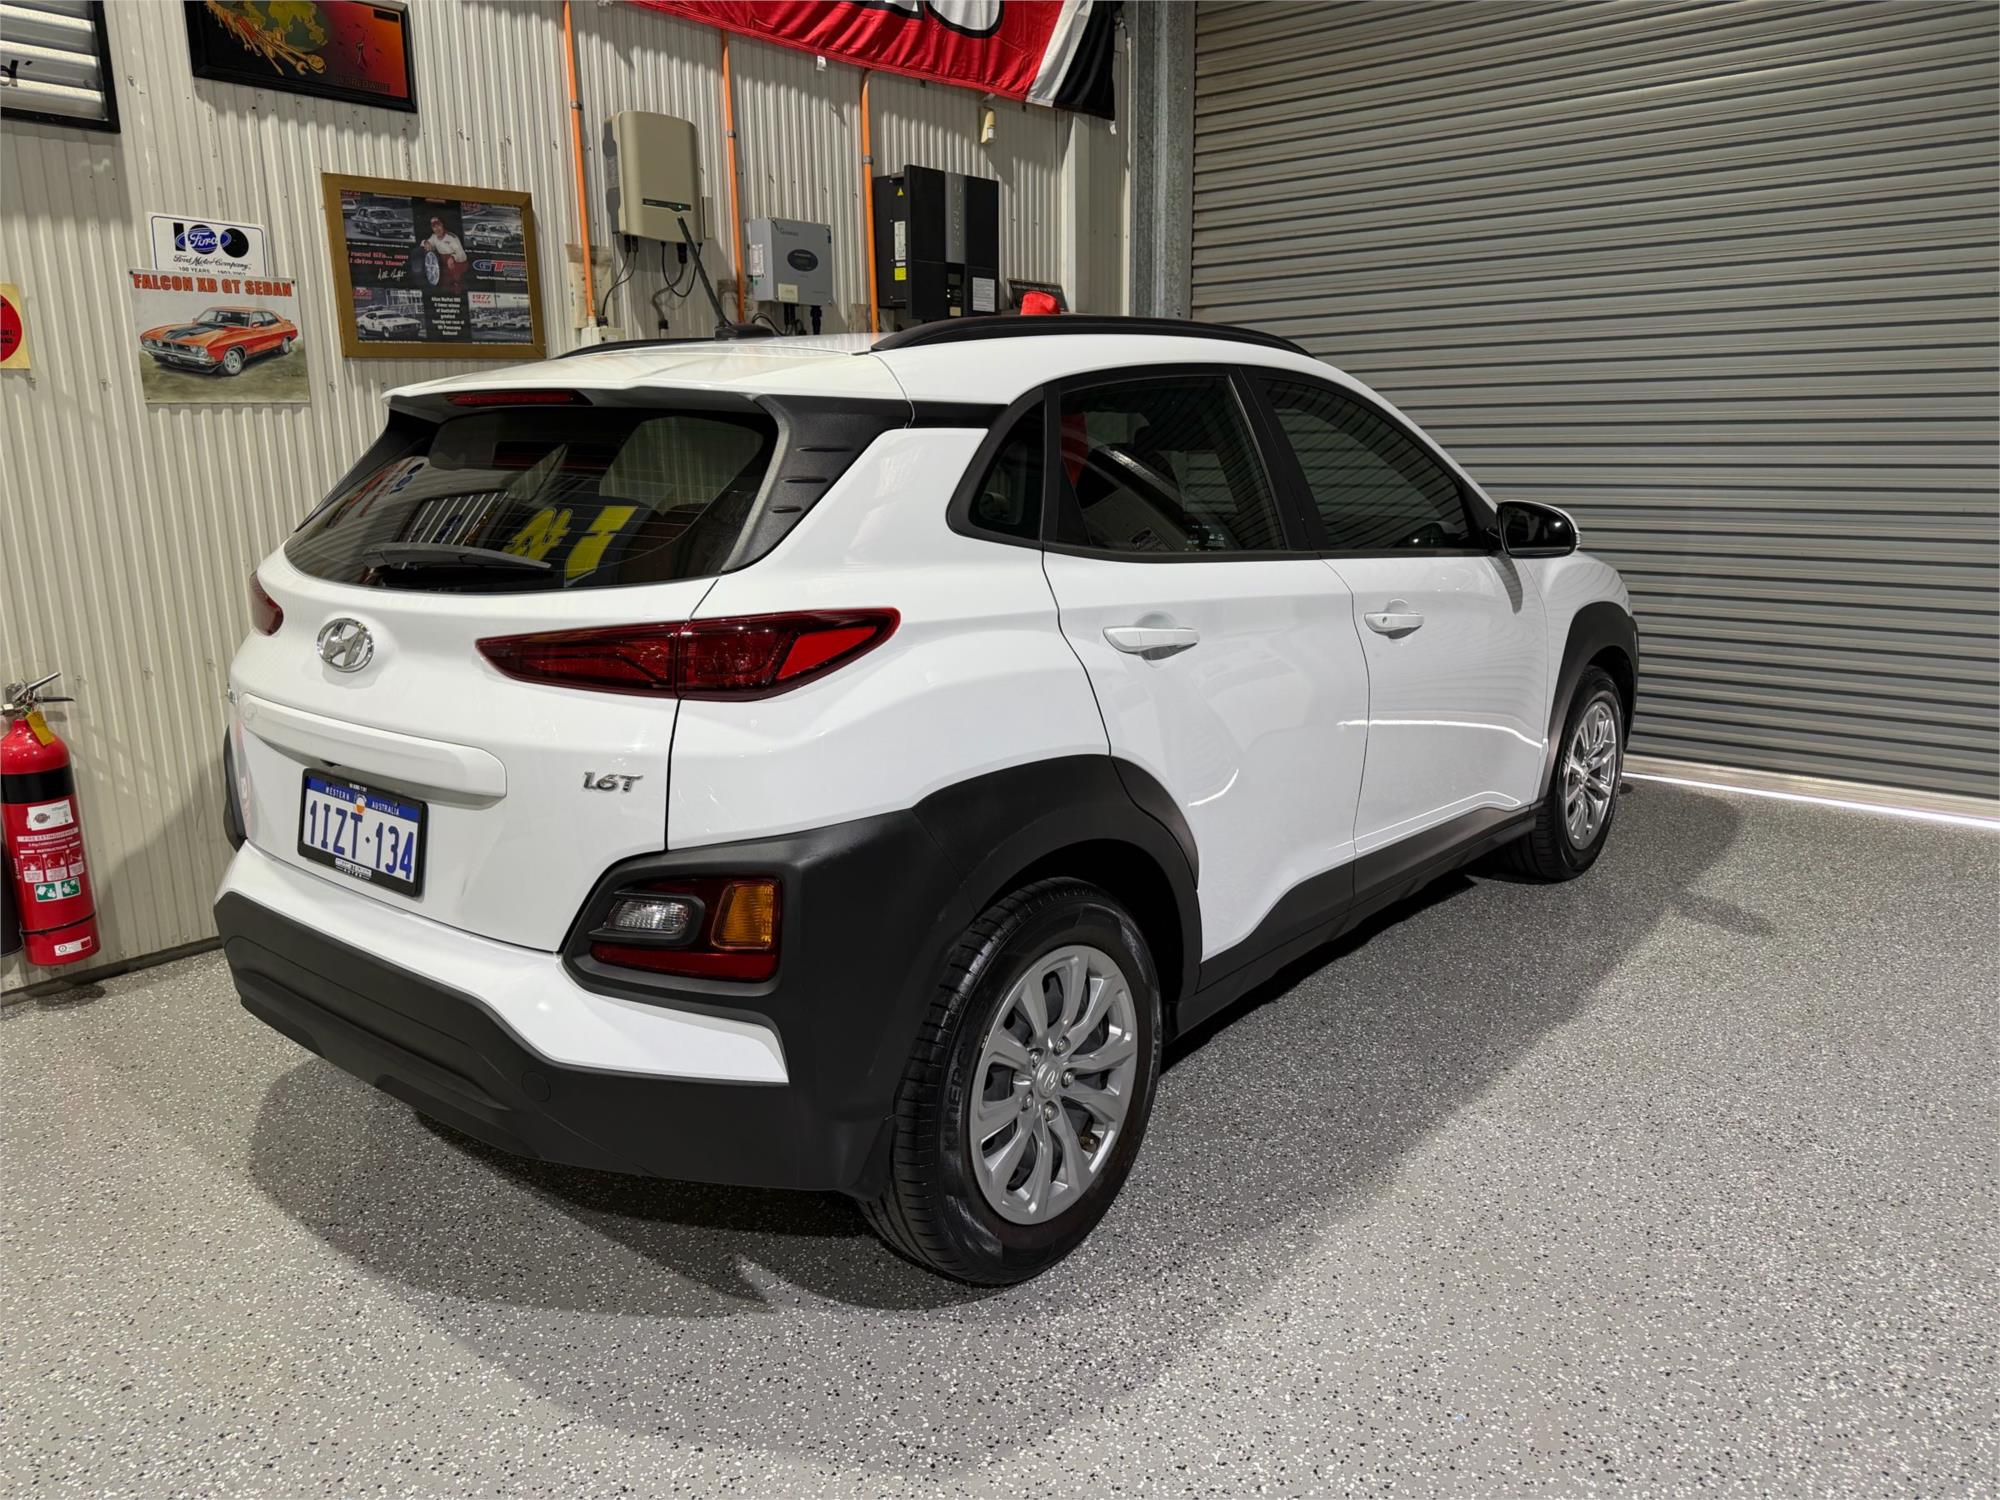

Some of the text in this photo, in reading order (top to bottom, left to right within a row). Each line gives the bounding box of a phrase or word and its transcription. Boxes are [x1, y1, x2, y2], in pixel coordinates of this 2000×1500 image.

[173, 254, 192, 263] Ford
[191, 256, 215, 266] Motor
[133, 274, 293, 297] FALCON XB GT SEDAN
[325, 786, 350, 801] WESTERN
[371, 800, 400, 815] AUSTRALIA
